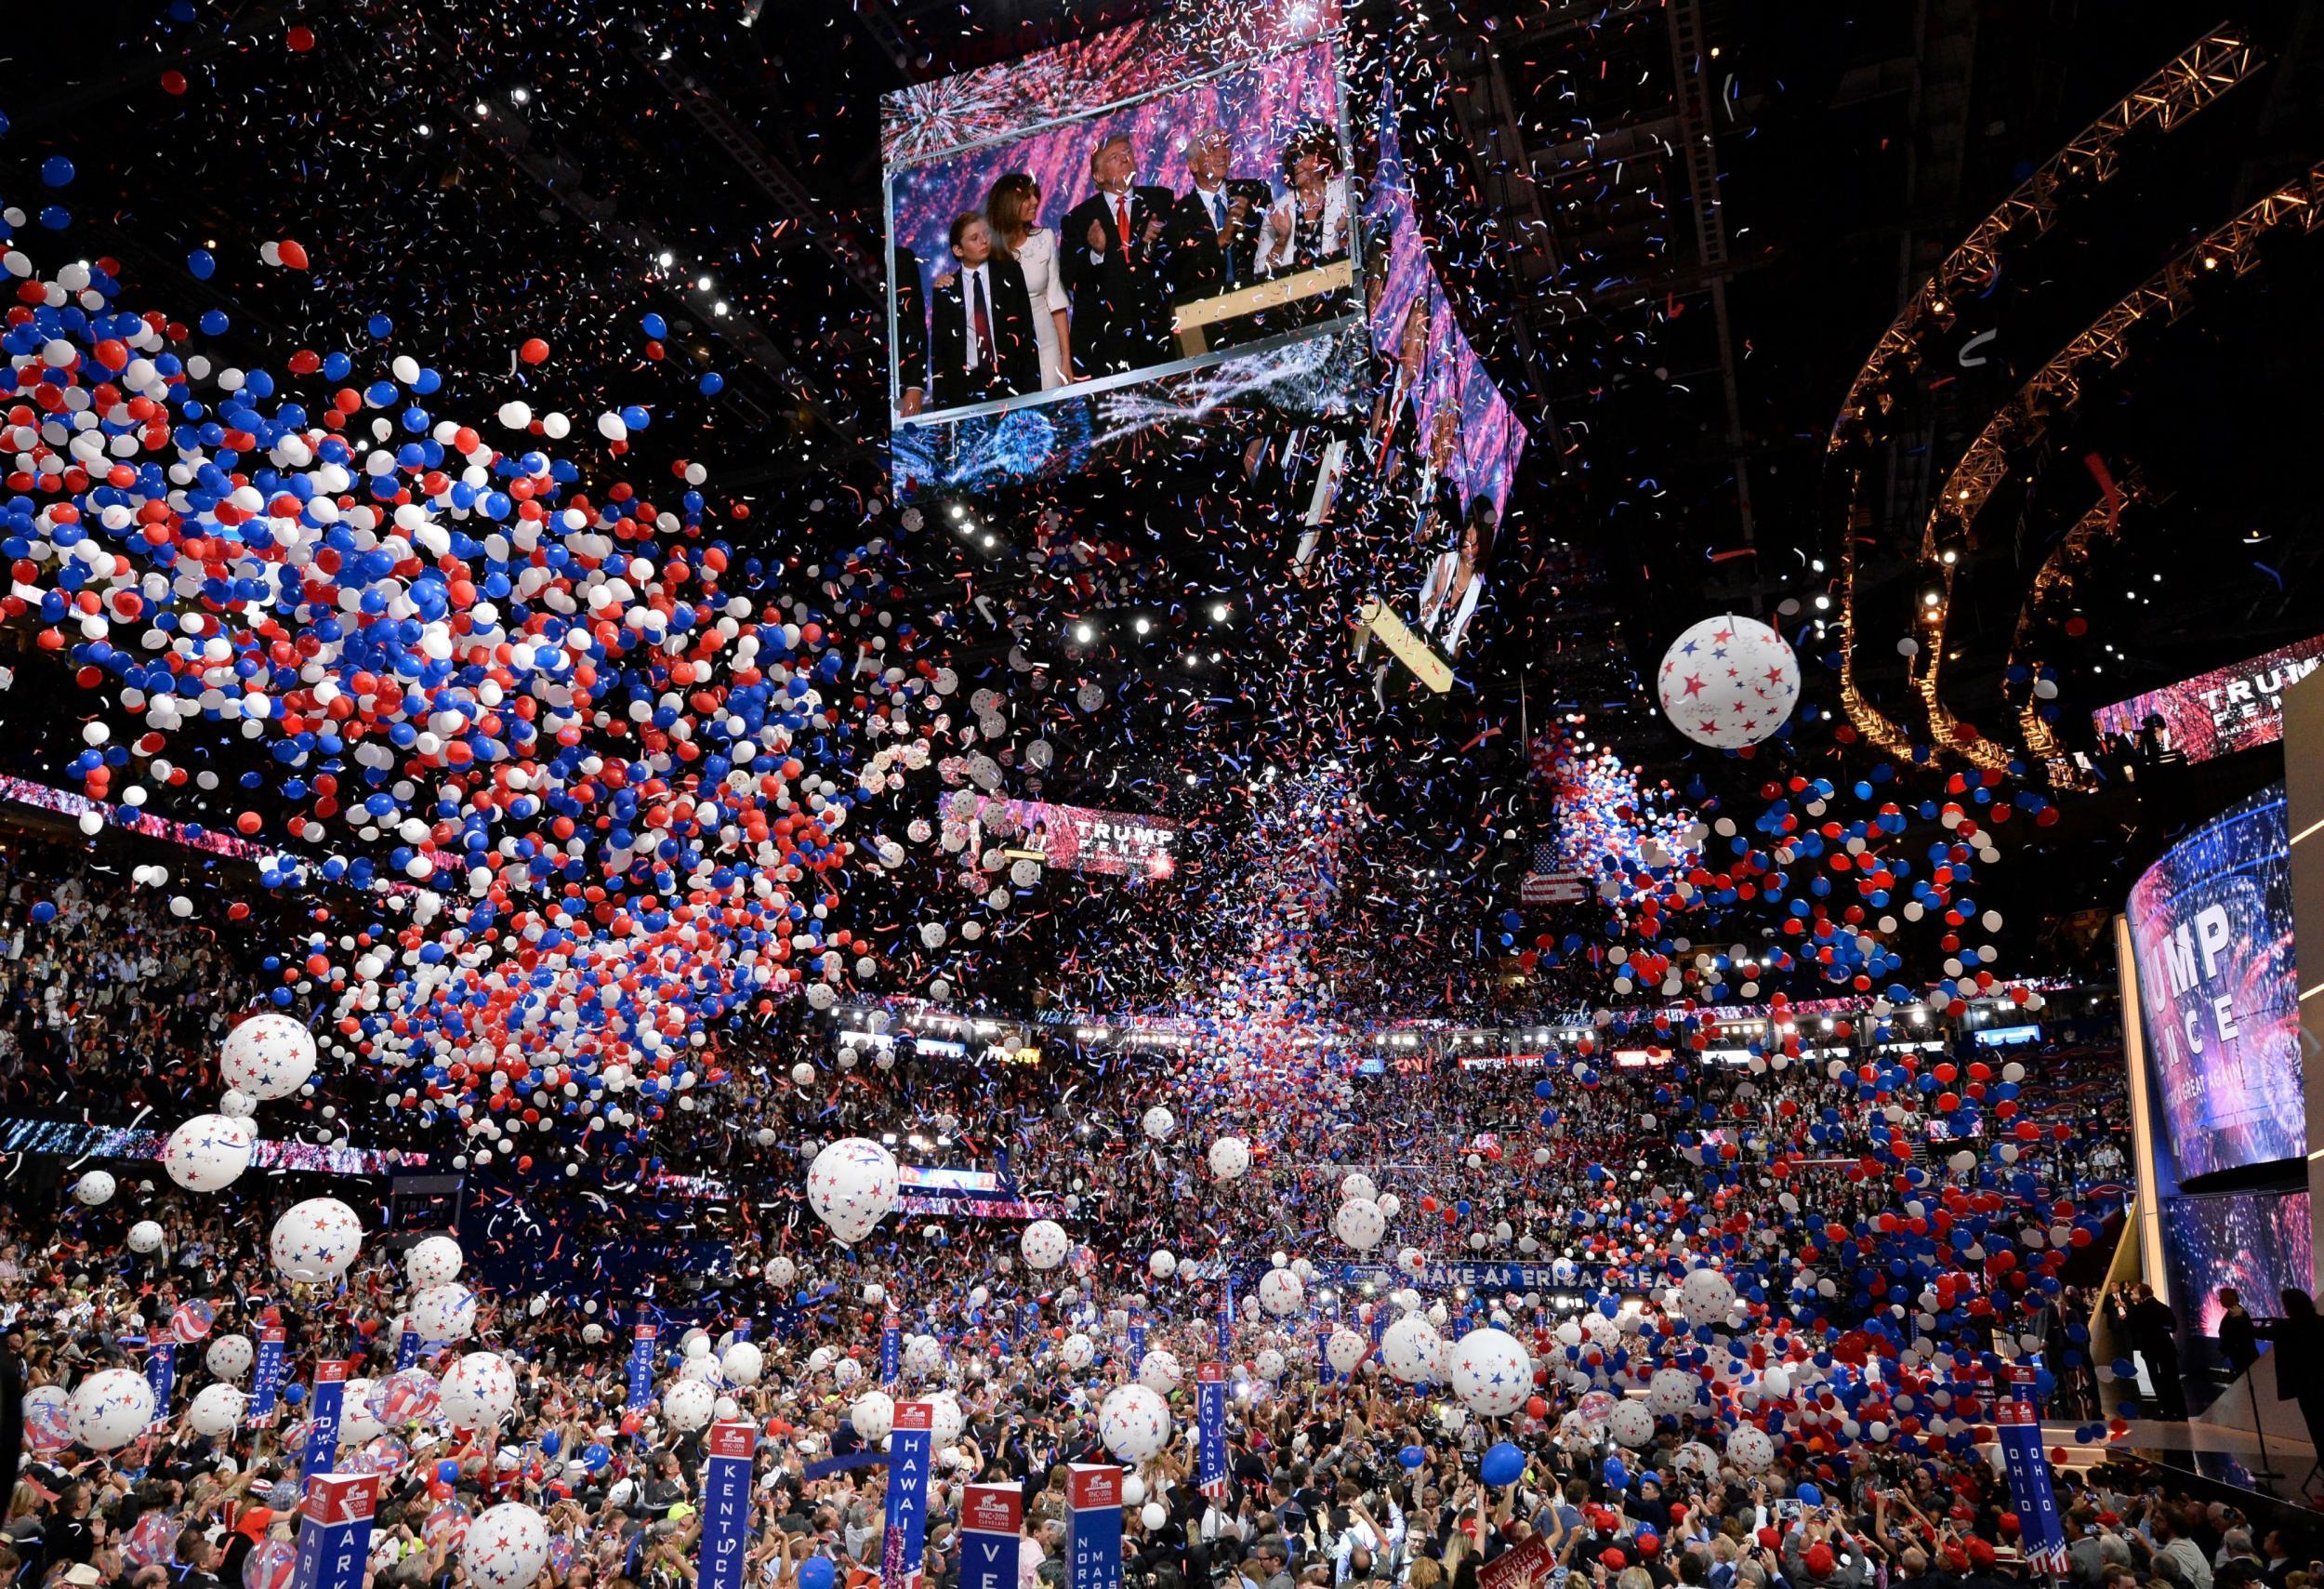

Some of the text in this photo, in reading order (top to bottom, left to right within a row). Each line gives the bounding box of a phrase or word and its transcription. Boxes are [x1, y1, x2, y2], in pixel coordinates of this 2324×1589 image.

[2199, 655, 2322, 710] TRUM
[2217, 725, 2242, 738] MAKE
[1075, 820, 1174, 845] TRUMP
[1078, 839, 1168, 857] PENCE
[1396, 1058, 1423, 1073] CNN
[2184, 1075, 2206, 1102] GREAT
[1412, 1267, 1672, 1289] MAKE AERIA GREA
[157, 1344, 167, 1374] NOTH
[252, 1344, 269, 1408] AMERICAN
[267, 1353, 280, 1392] SAMOA
[887, 1331, 895, 1376] NEVADA
[314, 1399, 332, 1463] IOWA
[1205, 1385, 1216, 1471] MARYLAND
[899, 1438, 918, 1550] HAWAII
[2009, 1448, 2031, 1512] OHIO
[2030, 1447, 2052, 1512] OHIO
[714, 1464, 737, 1589] KENTUCK
[978, 1518, 1009, 1528] CLEVELAND
[982, 1543, 1000, 1589] VE
[1486, 1542, 1545, 1588] AMERICA
